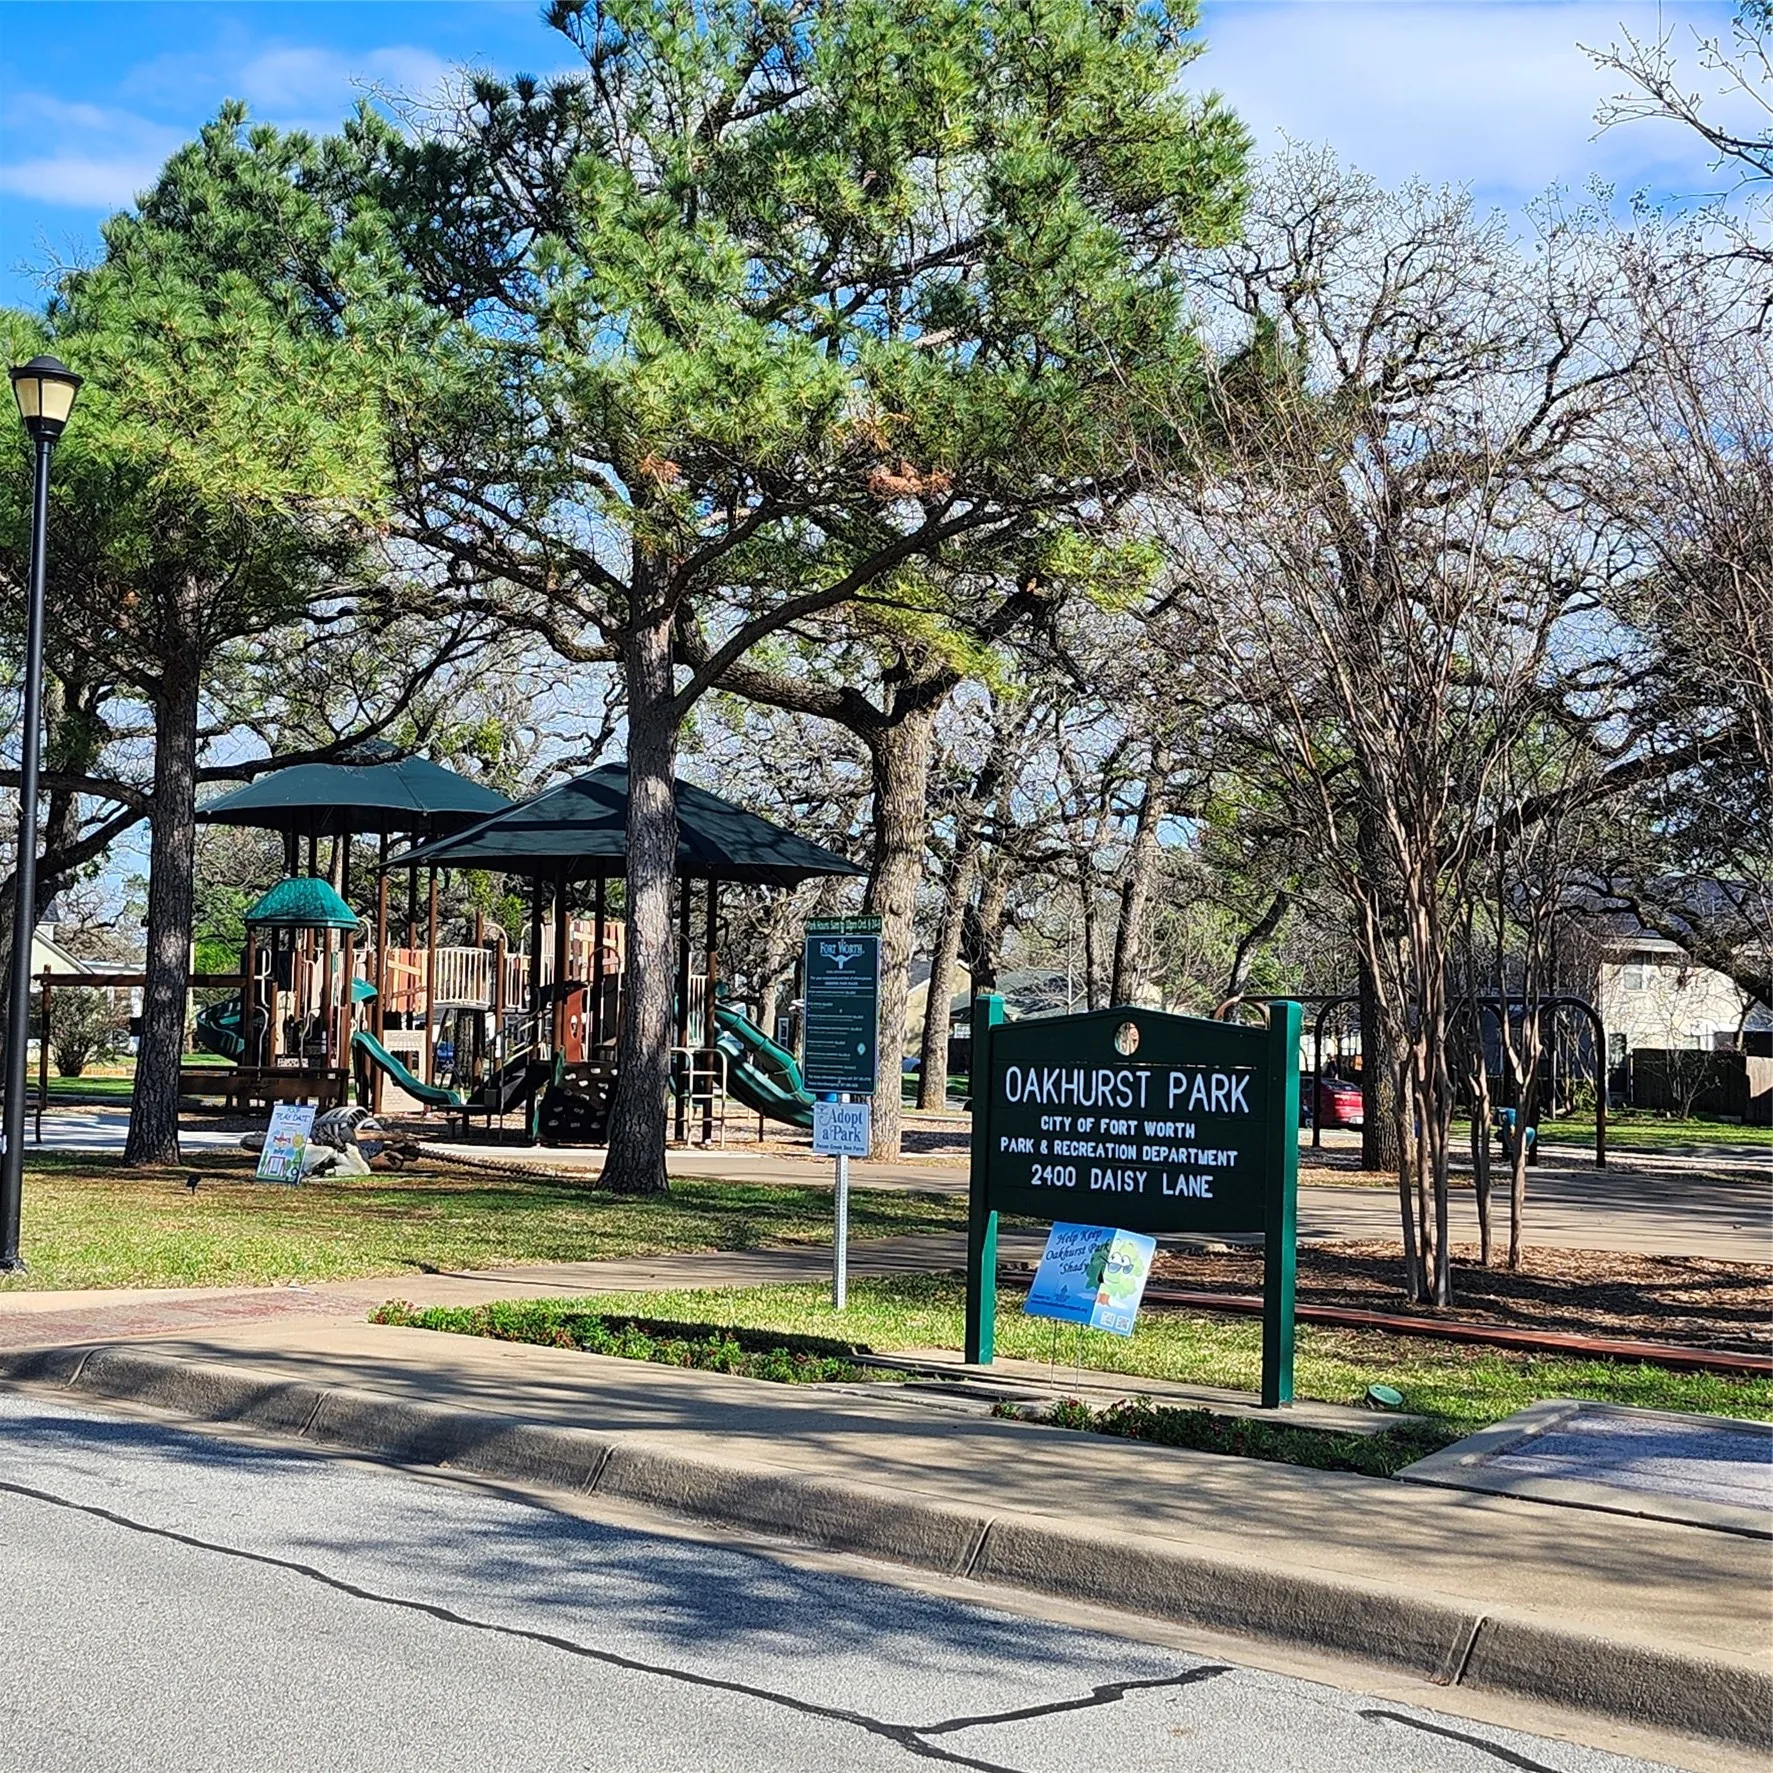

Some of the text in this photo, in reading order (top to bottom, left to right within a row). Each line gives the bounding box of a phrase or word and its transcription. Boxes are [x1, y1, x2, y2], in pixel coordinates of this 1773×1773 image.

[820, 941, 863, 954] FORT WORTH
[1005, 1066, 1250, 1113] OAKHURST PARK
[829, 1108, 863, 1128] Adopt
[1040, 1115, 1195, 1139] CITY OF FORT WORTH
[822, 1125, 861, 1142] a Park
[1000, 1136, 1238, 1167] PARK & RECREATION DEPARTMENT
[1030, 1164, 1214, 1199] 2400 DAISY LANE
[1055, 1229, 1103, 1246] Help Keep
[1045, 1238, 1112, 1261] Oakhurst Park
